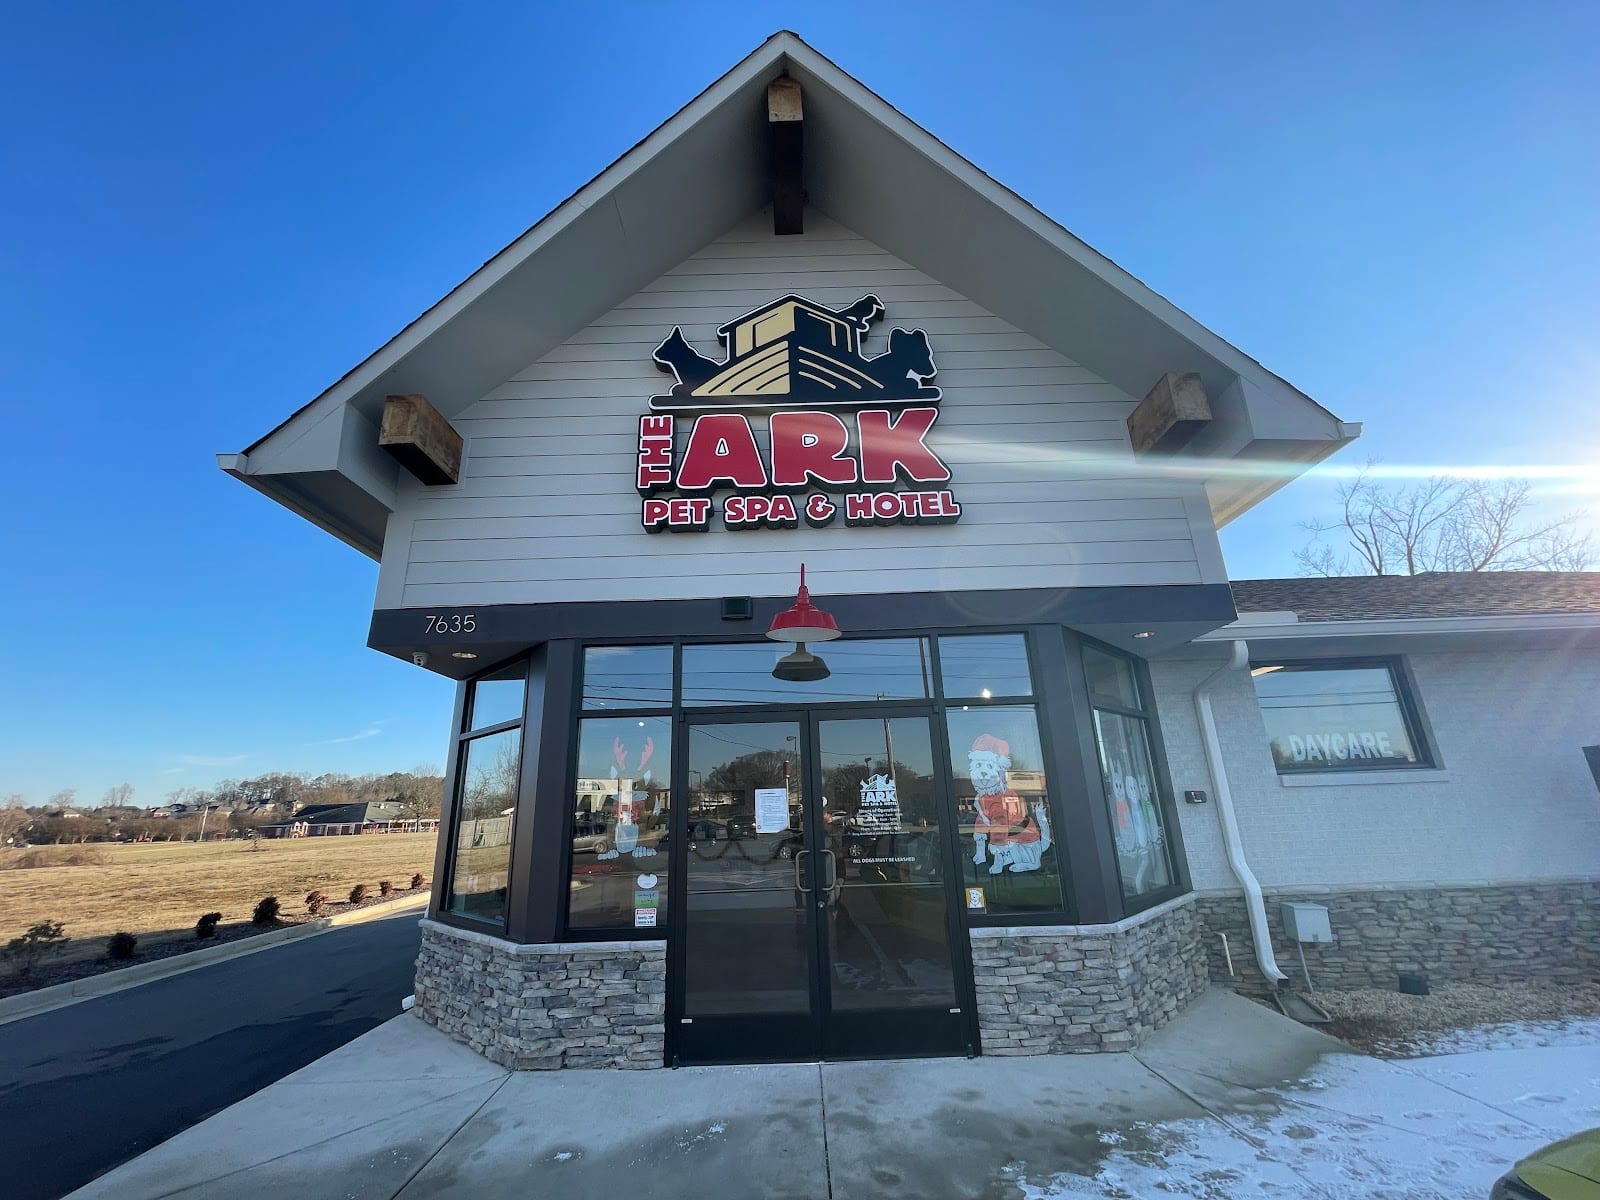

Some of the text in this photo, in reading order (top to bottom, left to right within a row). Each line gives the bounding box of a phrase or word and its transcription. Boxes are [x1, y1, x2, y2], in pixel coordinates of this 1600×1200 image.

[637, 408, 951, 489] THE ARK
[643, 491, 960, 526] PET SPA & HOTEL
[424, 614, 476, 634] 7635
[1288, 731, 1394, 762] DAYCARE
[866, 791, 897, 802] ARK
